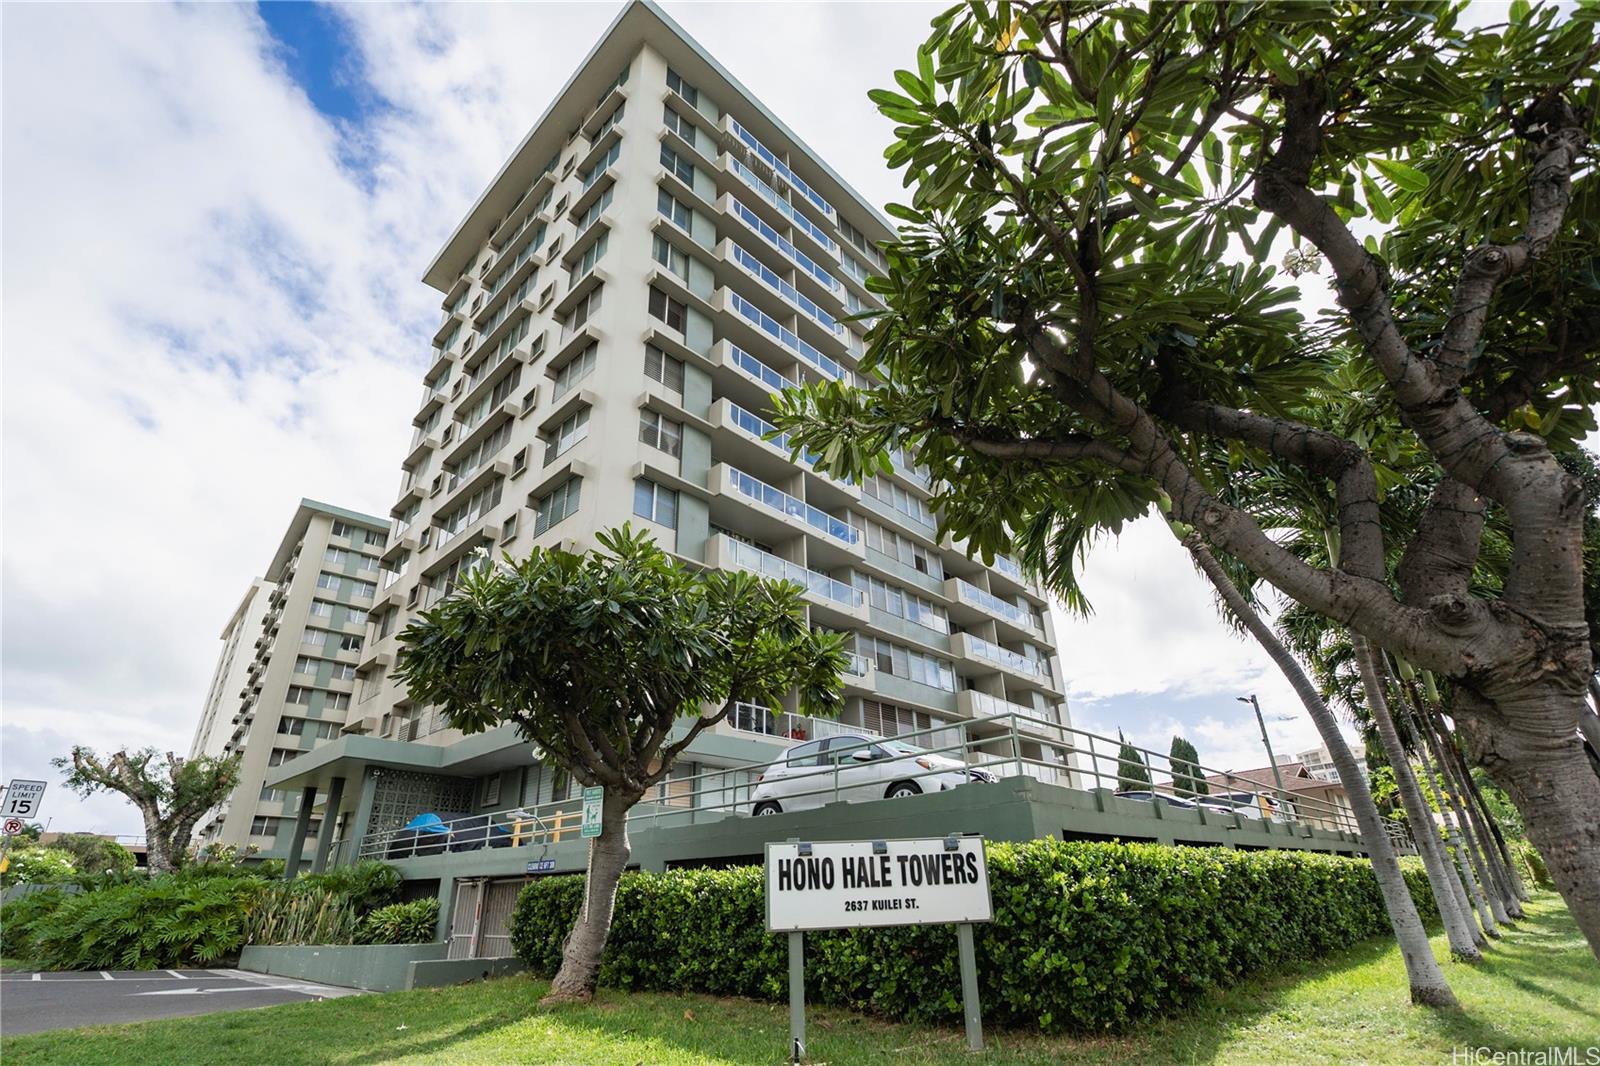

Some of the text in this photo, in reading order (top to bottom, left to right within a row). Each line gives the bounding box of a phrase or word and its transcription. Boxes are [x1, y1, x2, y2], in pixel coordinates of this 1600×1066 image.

[12, 784, 43, 792] SPEED
[10, 800, 32, 814] 15
[779, 852, 979, 891] HONO HALE TOWERS
[845, 898, 920, 912] 2637 KUILEI ST.
